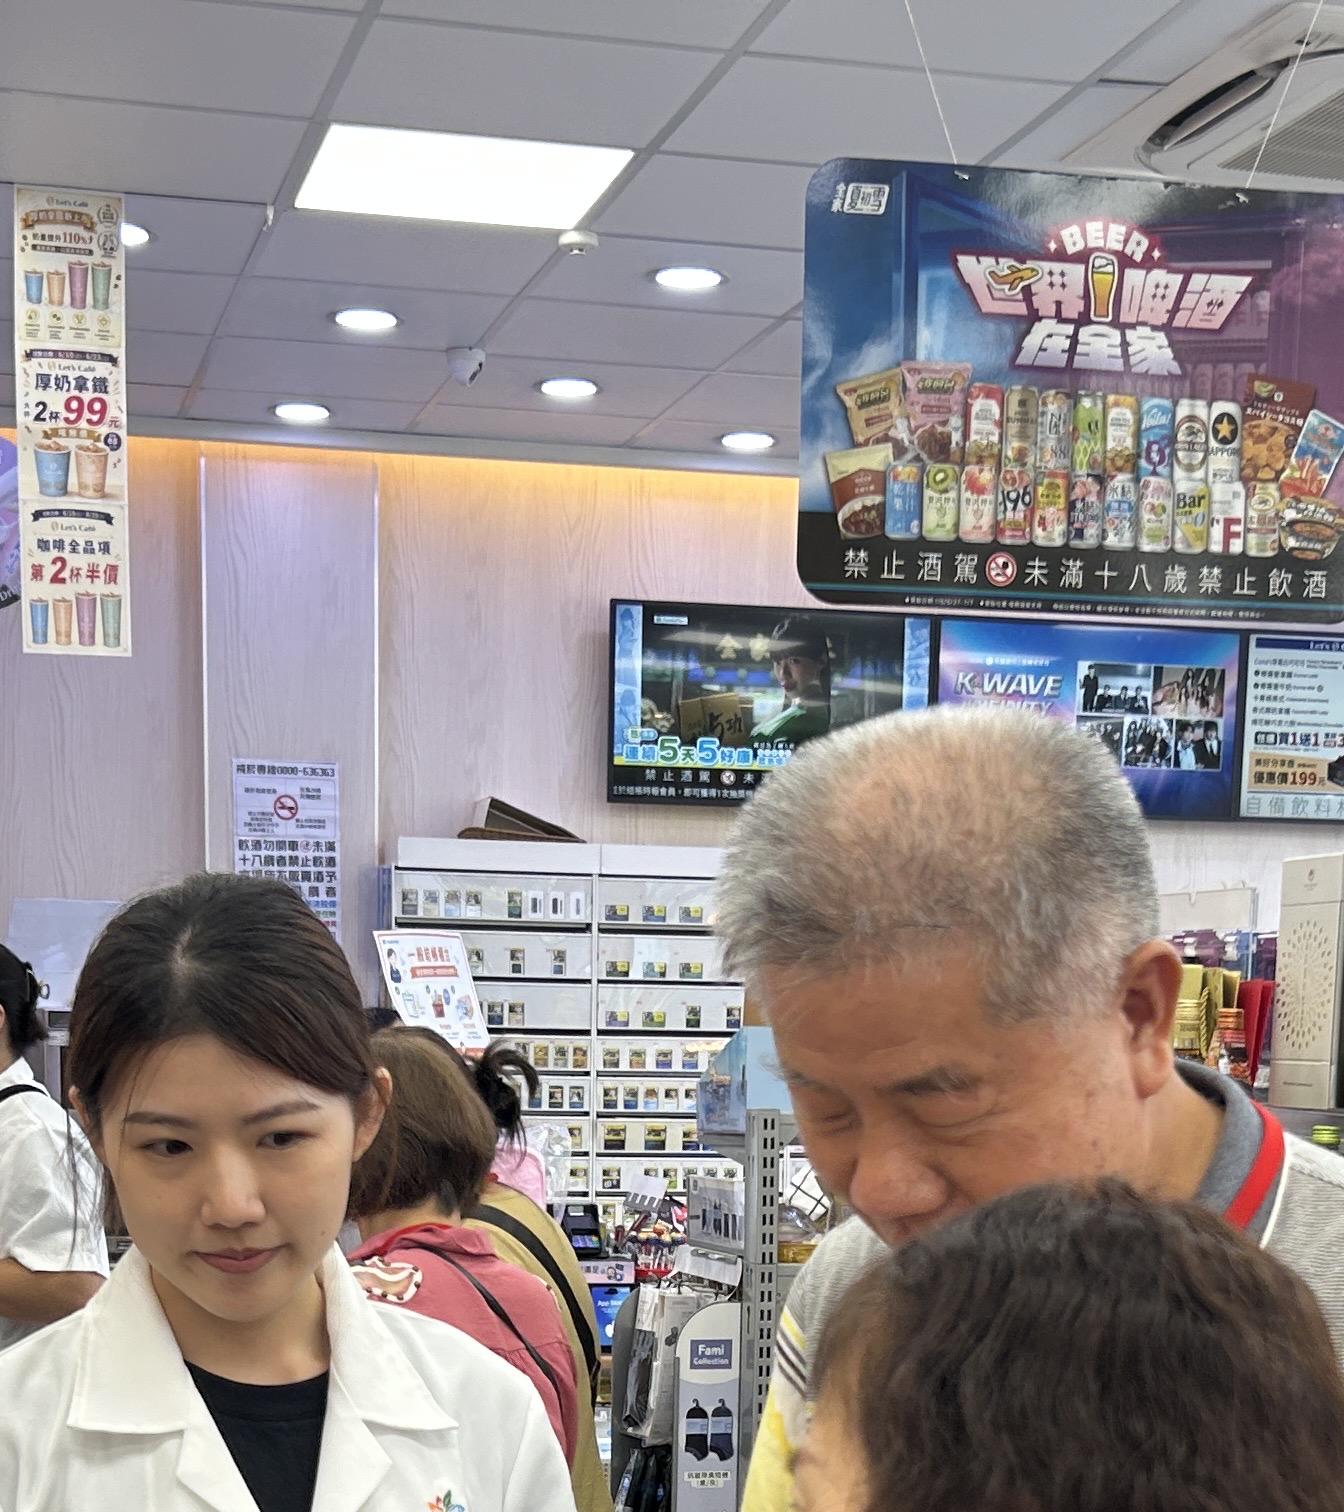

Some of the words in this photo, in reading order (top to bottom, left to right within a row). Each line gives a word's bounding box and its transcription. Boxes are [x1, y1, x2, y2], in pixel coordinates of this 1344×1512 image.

[1060, 221, 1151, 263] BEER
[35, 372, 109, 395] 厚奶拿鐵
[37, 538, 112, 556] 咖啡全品項
[30, 556, 120, 586] 第2杯半價
[843, 549, 979, 584] 禁止酒駕
[1024, 559, 1329, 599] 未滿十八歲禁止飲酒
[983, 672, 1064, 699] WAVE
[693, 1357, 729, 1366] Collection
[698, 1344, 725, 1356] Fami
